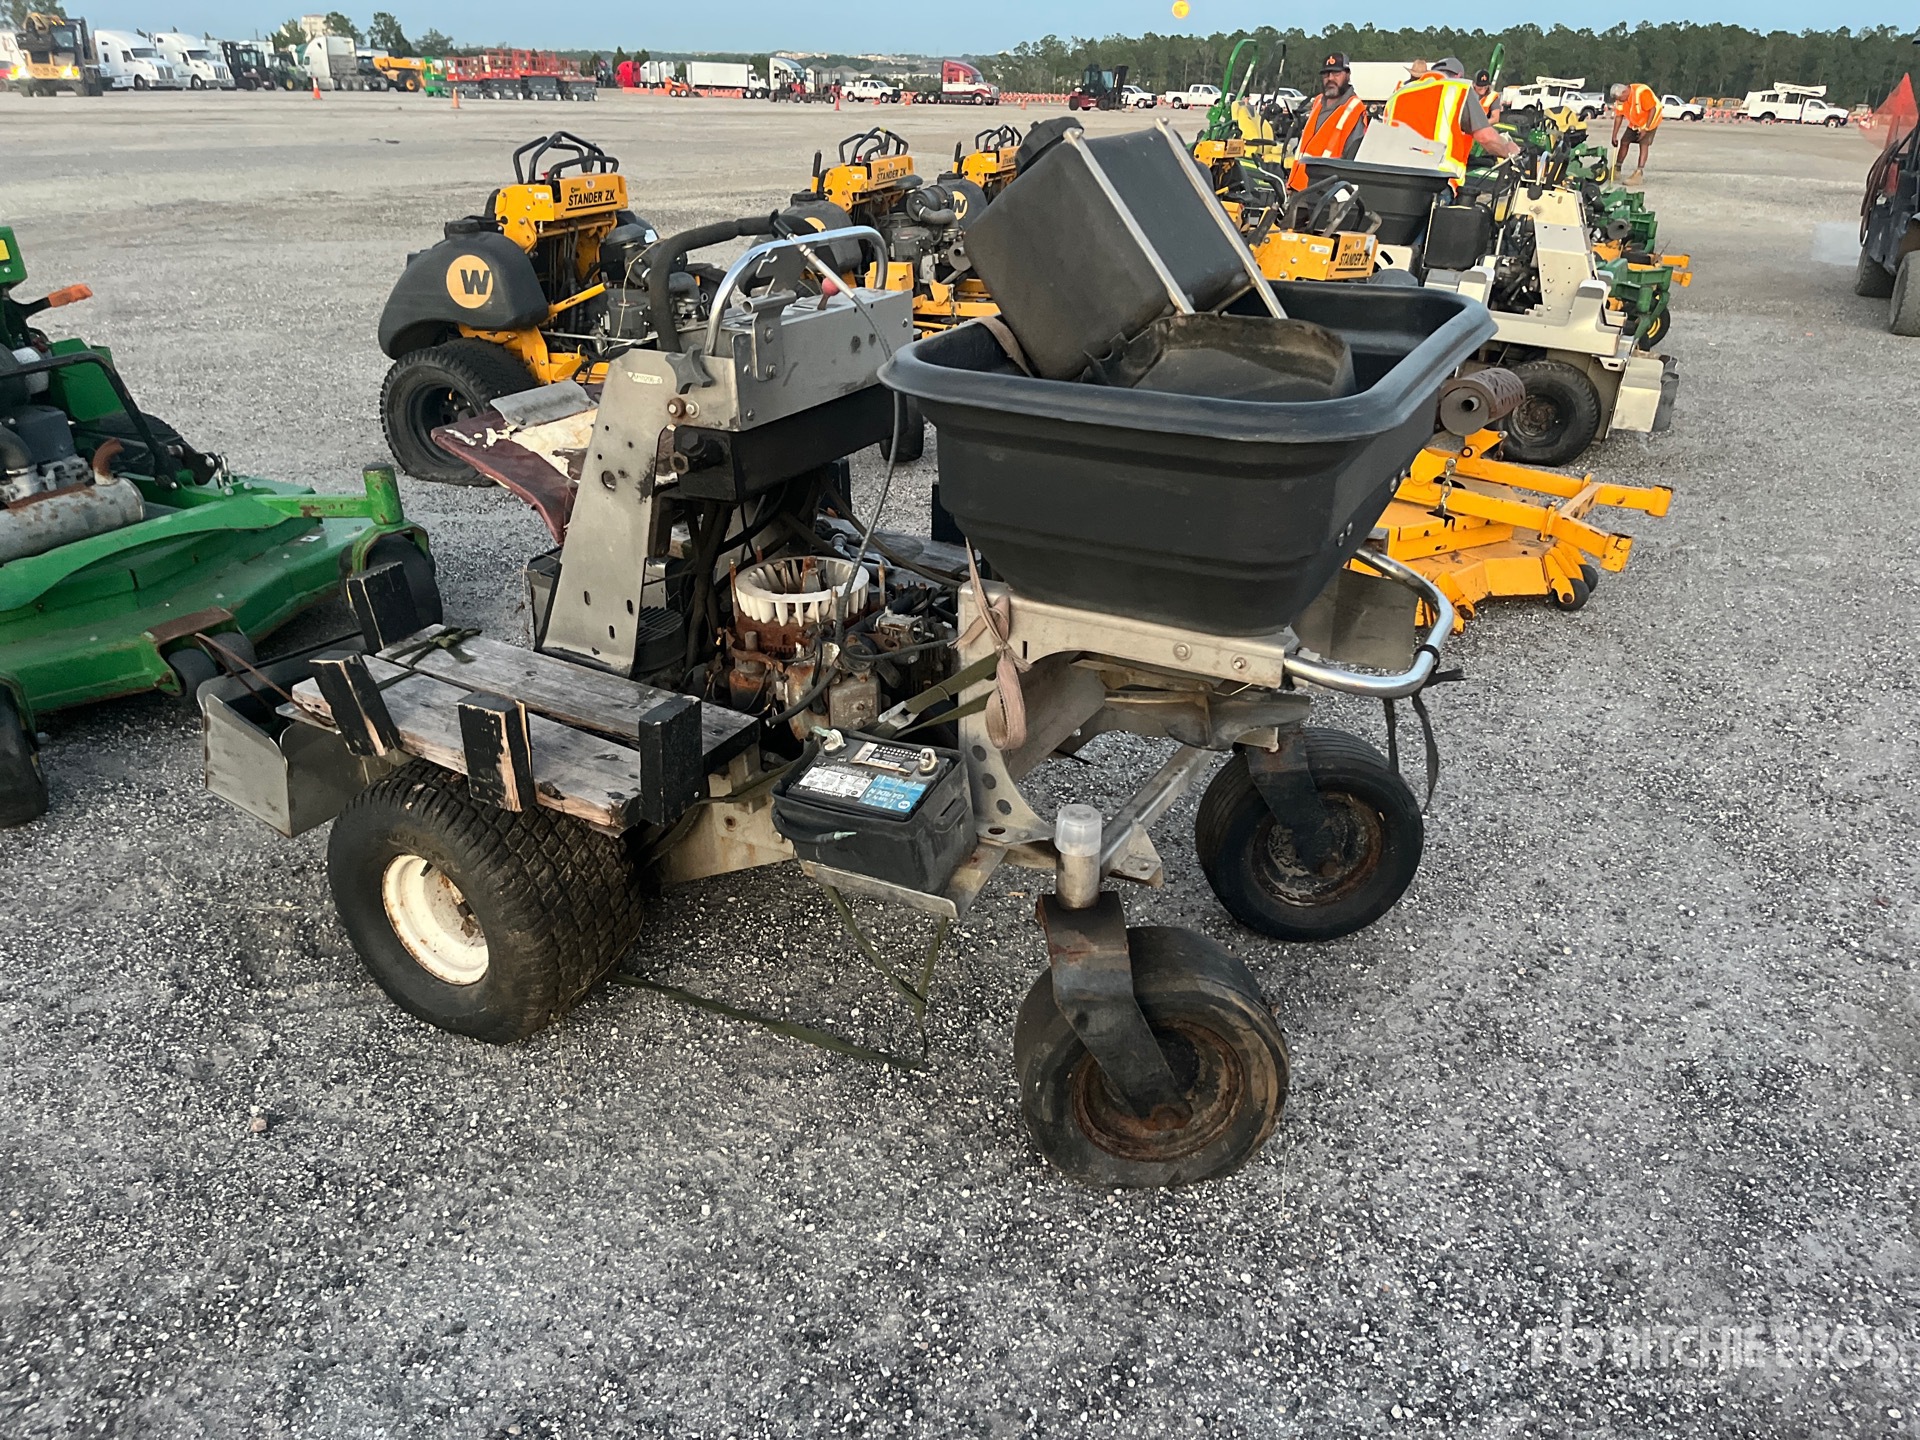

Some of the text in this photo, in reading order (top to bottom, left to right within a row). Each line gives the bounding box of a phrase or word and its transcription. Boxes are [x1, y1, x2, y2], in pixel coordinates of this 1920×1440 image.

[876, 169, 899, 182] STANDER
[568, 189, 616, 207] STANDER ZK
[460, 269, 491, 295] W
